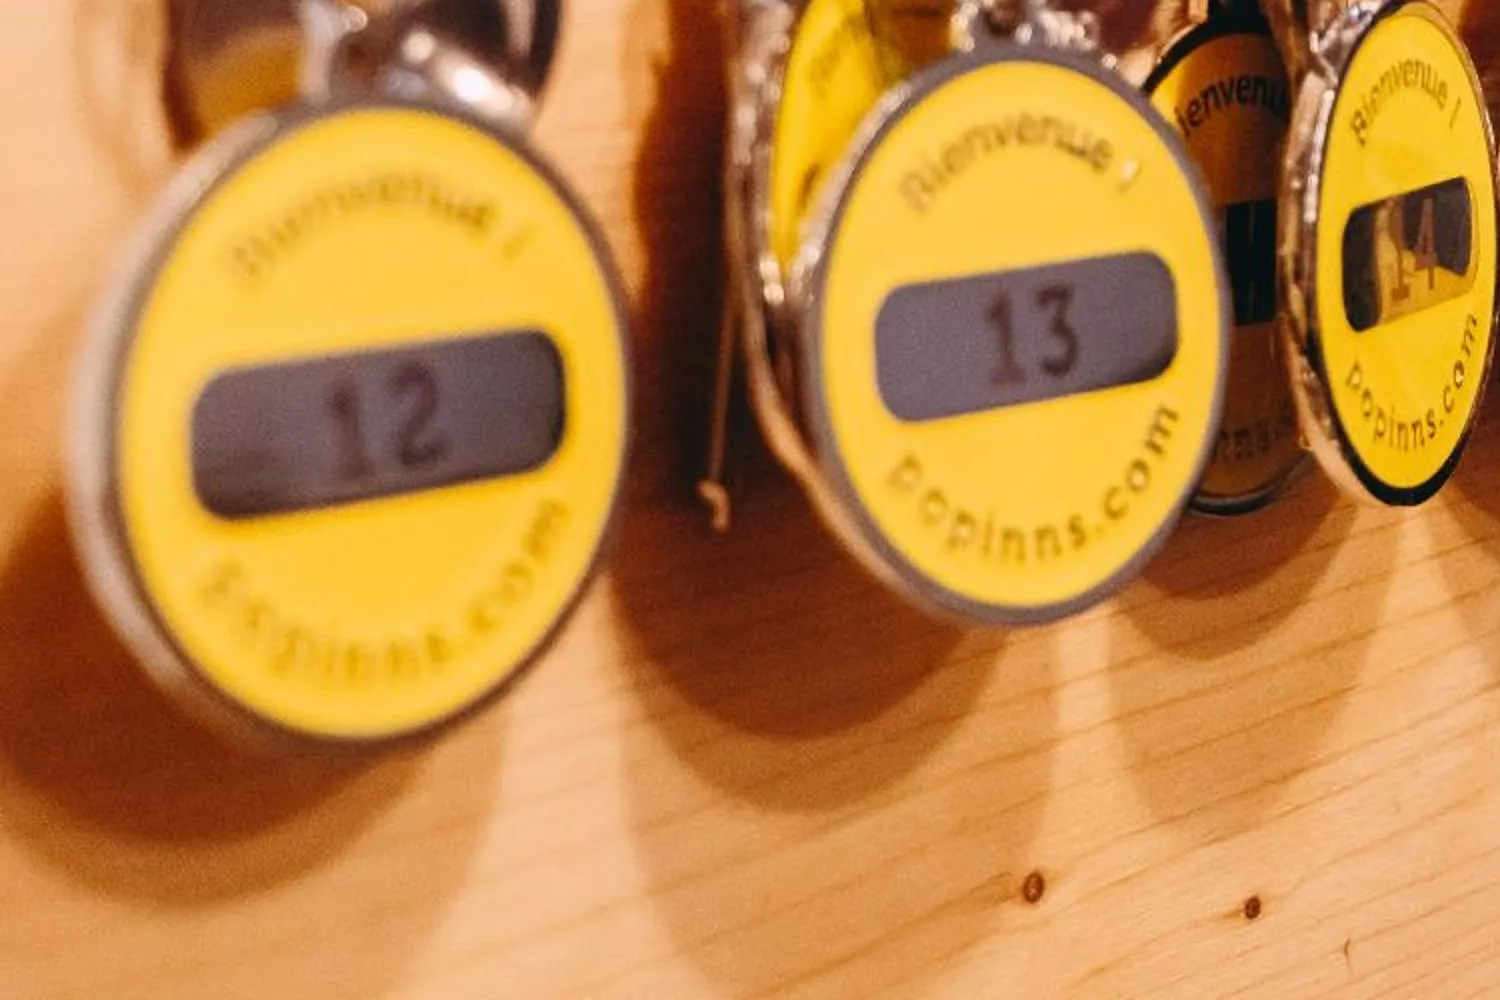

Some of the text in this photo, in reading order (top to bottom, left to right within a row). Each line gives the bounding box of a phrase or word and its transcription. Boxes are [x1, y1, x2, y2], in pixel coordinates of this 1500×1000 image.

[1174, 70, 1290, 139] ienvenu
[1350, 56, 1448, 147] Bienvenue
[898, 108, 1114, 216] Bienvenue
[1387, 197, 1438, 302] 14
[982, 282, 1080, 391] 13
[1345, 311, 1479, 452] popinns.com
[325, 360, 452, 482] 12
[887, 403, 1180, 565] popinns.com
